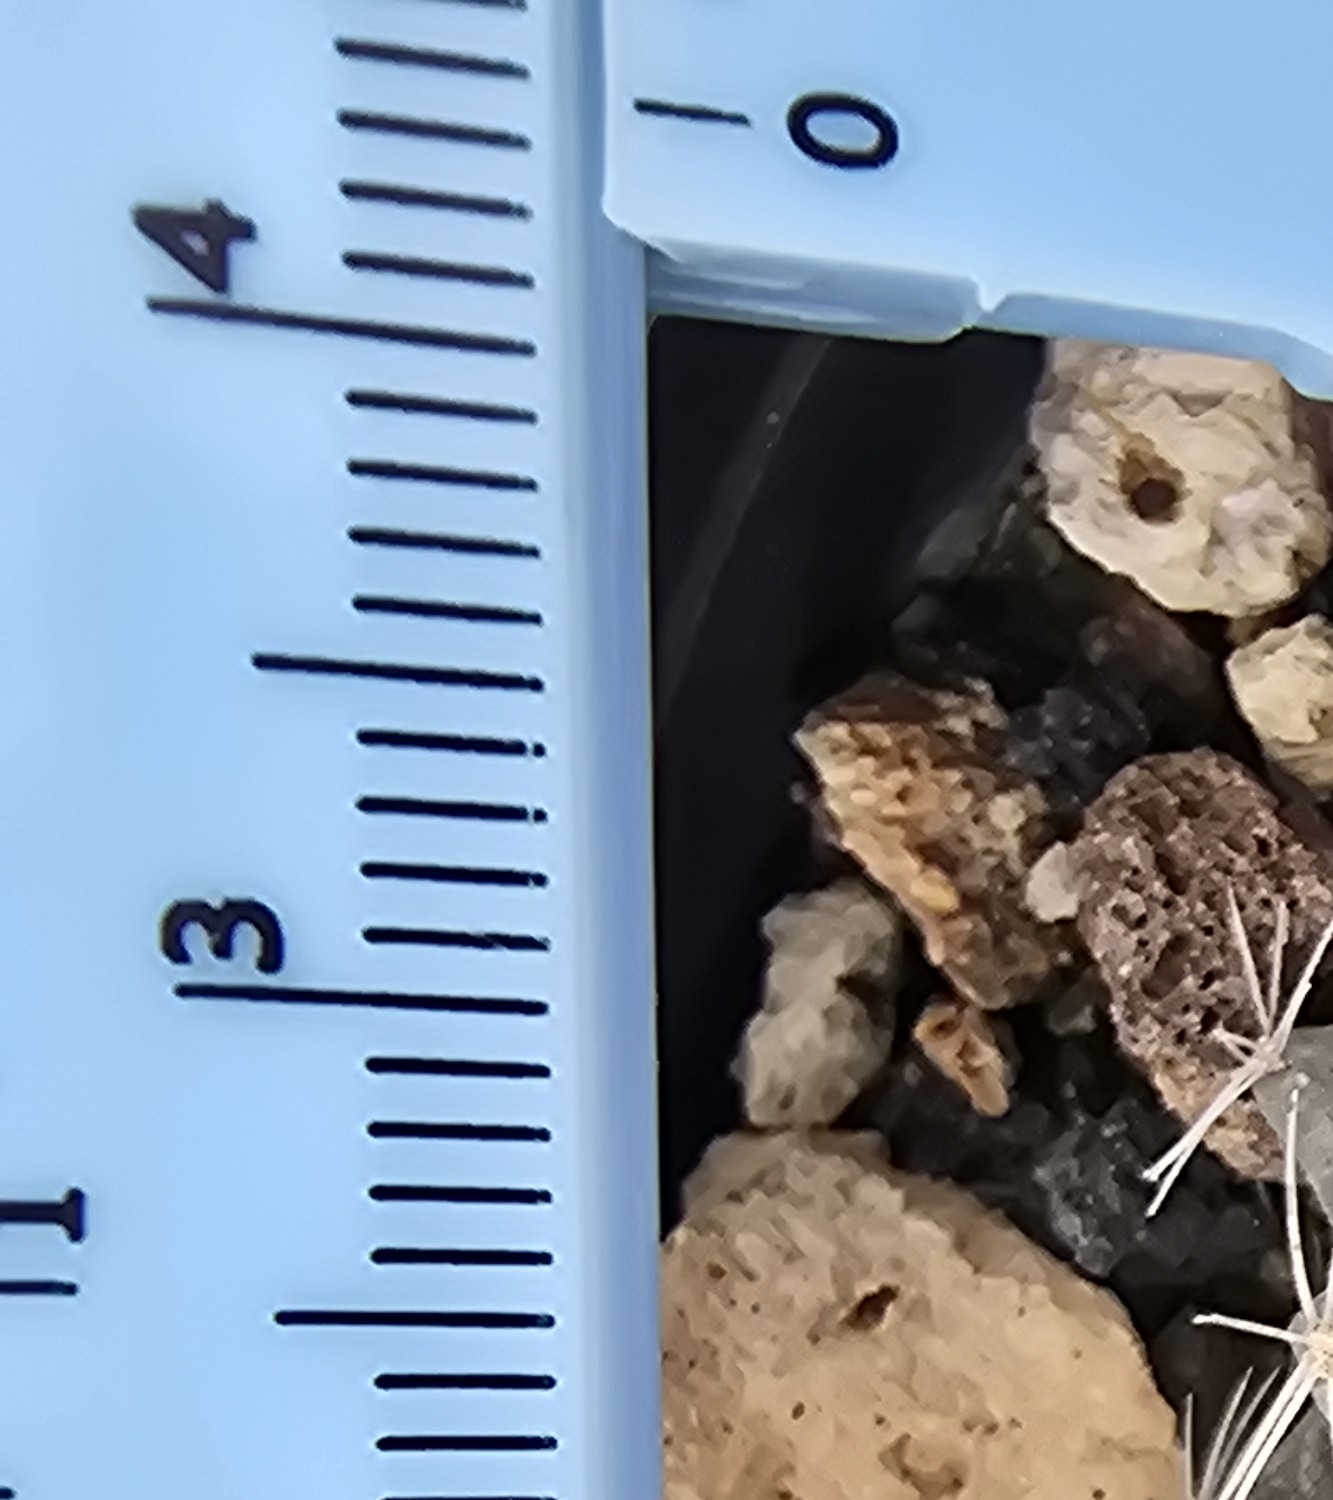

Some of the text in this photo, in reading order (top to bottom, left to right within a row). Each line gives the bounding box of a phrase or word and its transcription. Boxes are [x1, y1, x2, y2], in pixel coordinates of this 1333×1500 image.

[786, 93, 899, 170] 0
[132, 199, 257, 293] 4
[160, 897, 285, 974] 3
